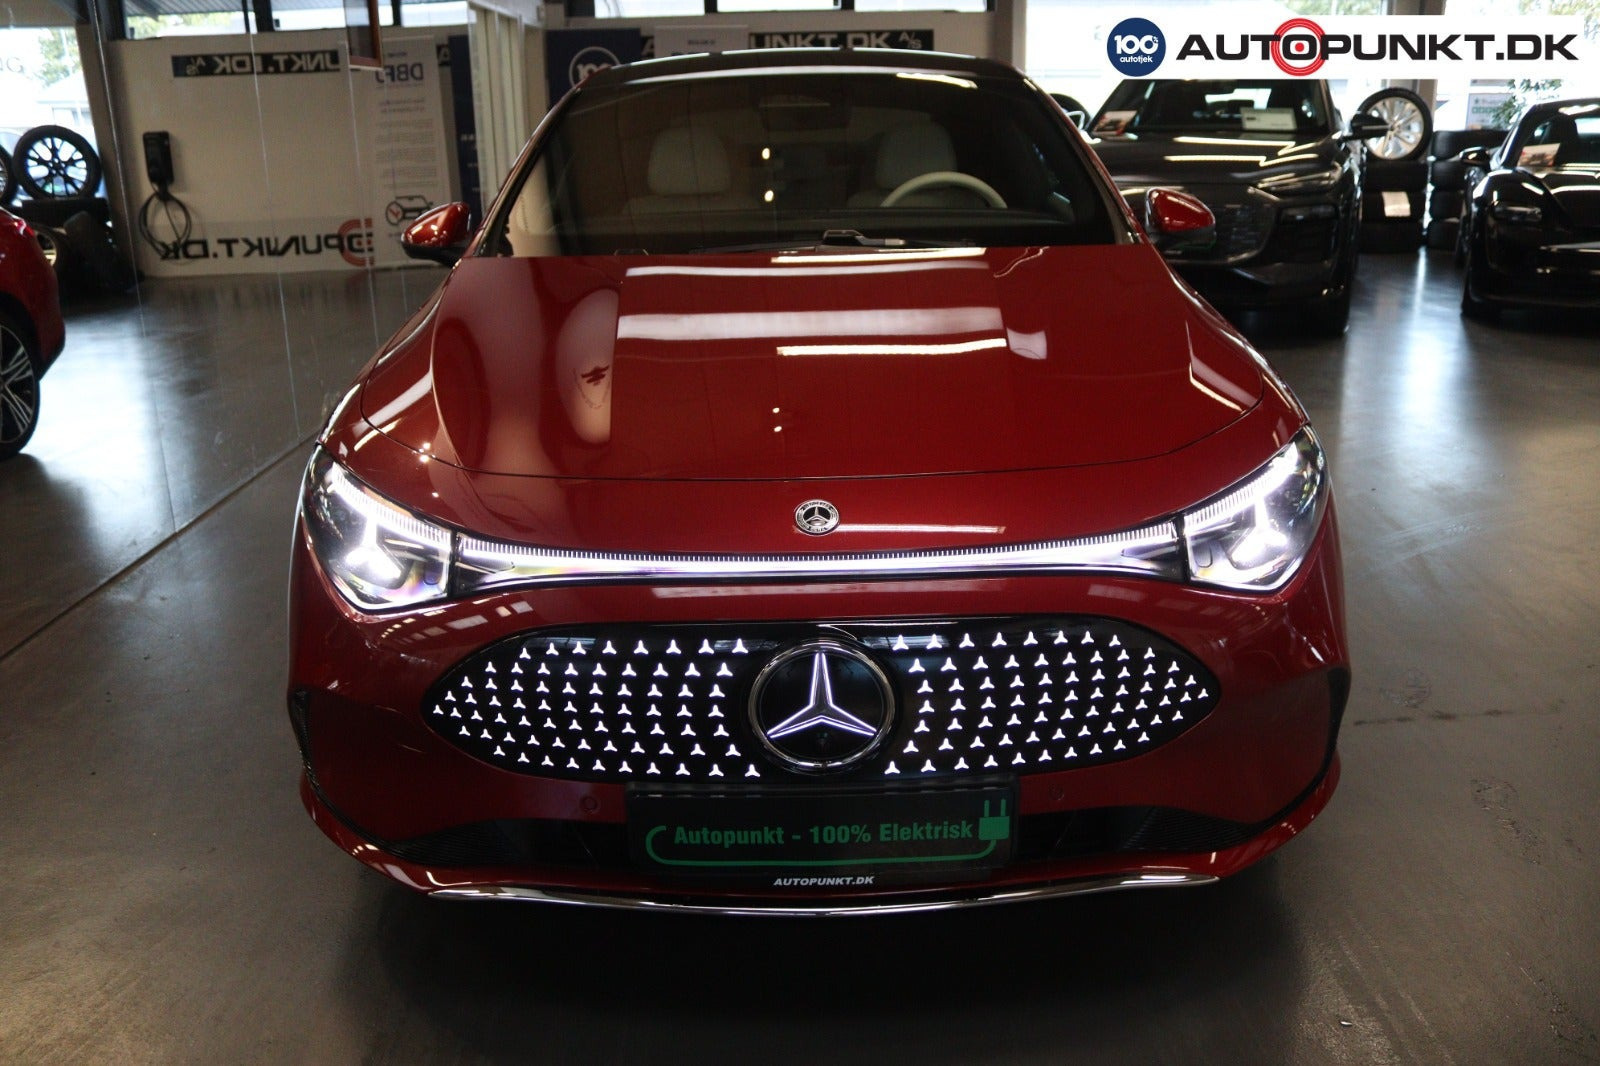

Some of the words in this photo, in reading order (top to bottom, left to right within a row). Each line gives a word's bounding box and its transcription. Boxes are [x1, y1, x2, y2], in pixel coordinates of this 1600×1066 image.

[674, 826, 785, 848] Autopunkt
[809, 824, 872, 844] 100%
[879, 820, 974, 842] Elektrisk
[773, 876, 875, 887] AUTOPUNKT.DK
